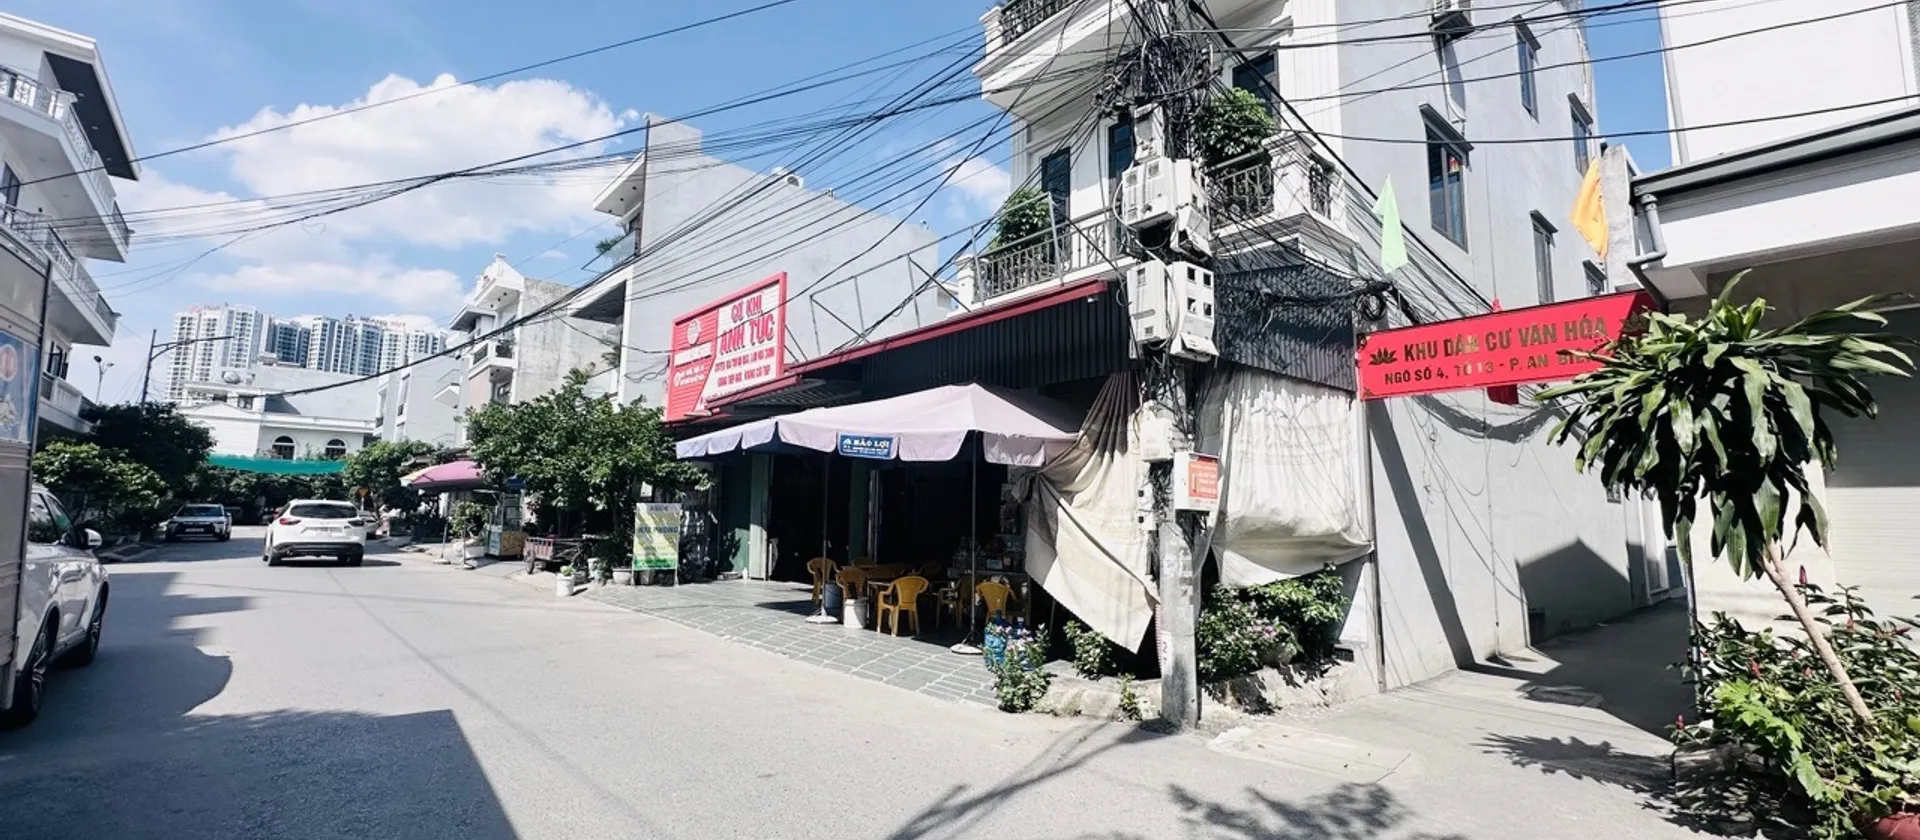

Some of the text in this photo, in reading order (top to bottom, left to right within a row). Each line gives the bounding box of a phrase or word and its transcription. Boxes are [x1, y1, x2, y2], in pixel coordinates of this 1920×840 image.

[1404, 340, 1438, 362] KHU
[1485, 328, 1512, 351] CƯ
[1565, 313, 1608, 341] HÓA
[1477, 361, 1494, 374] 13
[1528, 354, 1549, 369] AN
